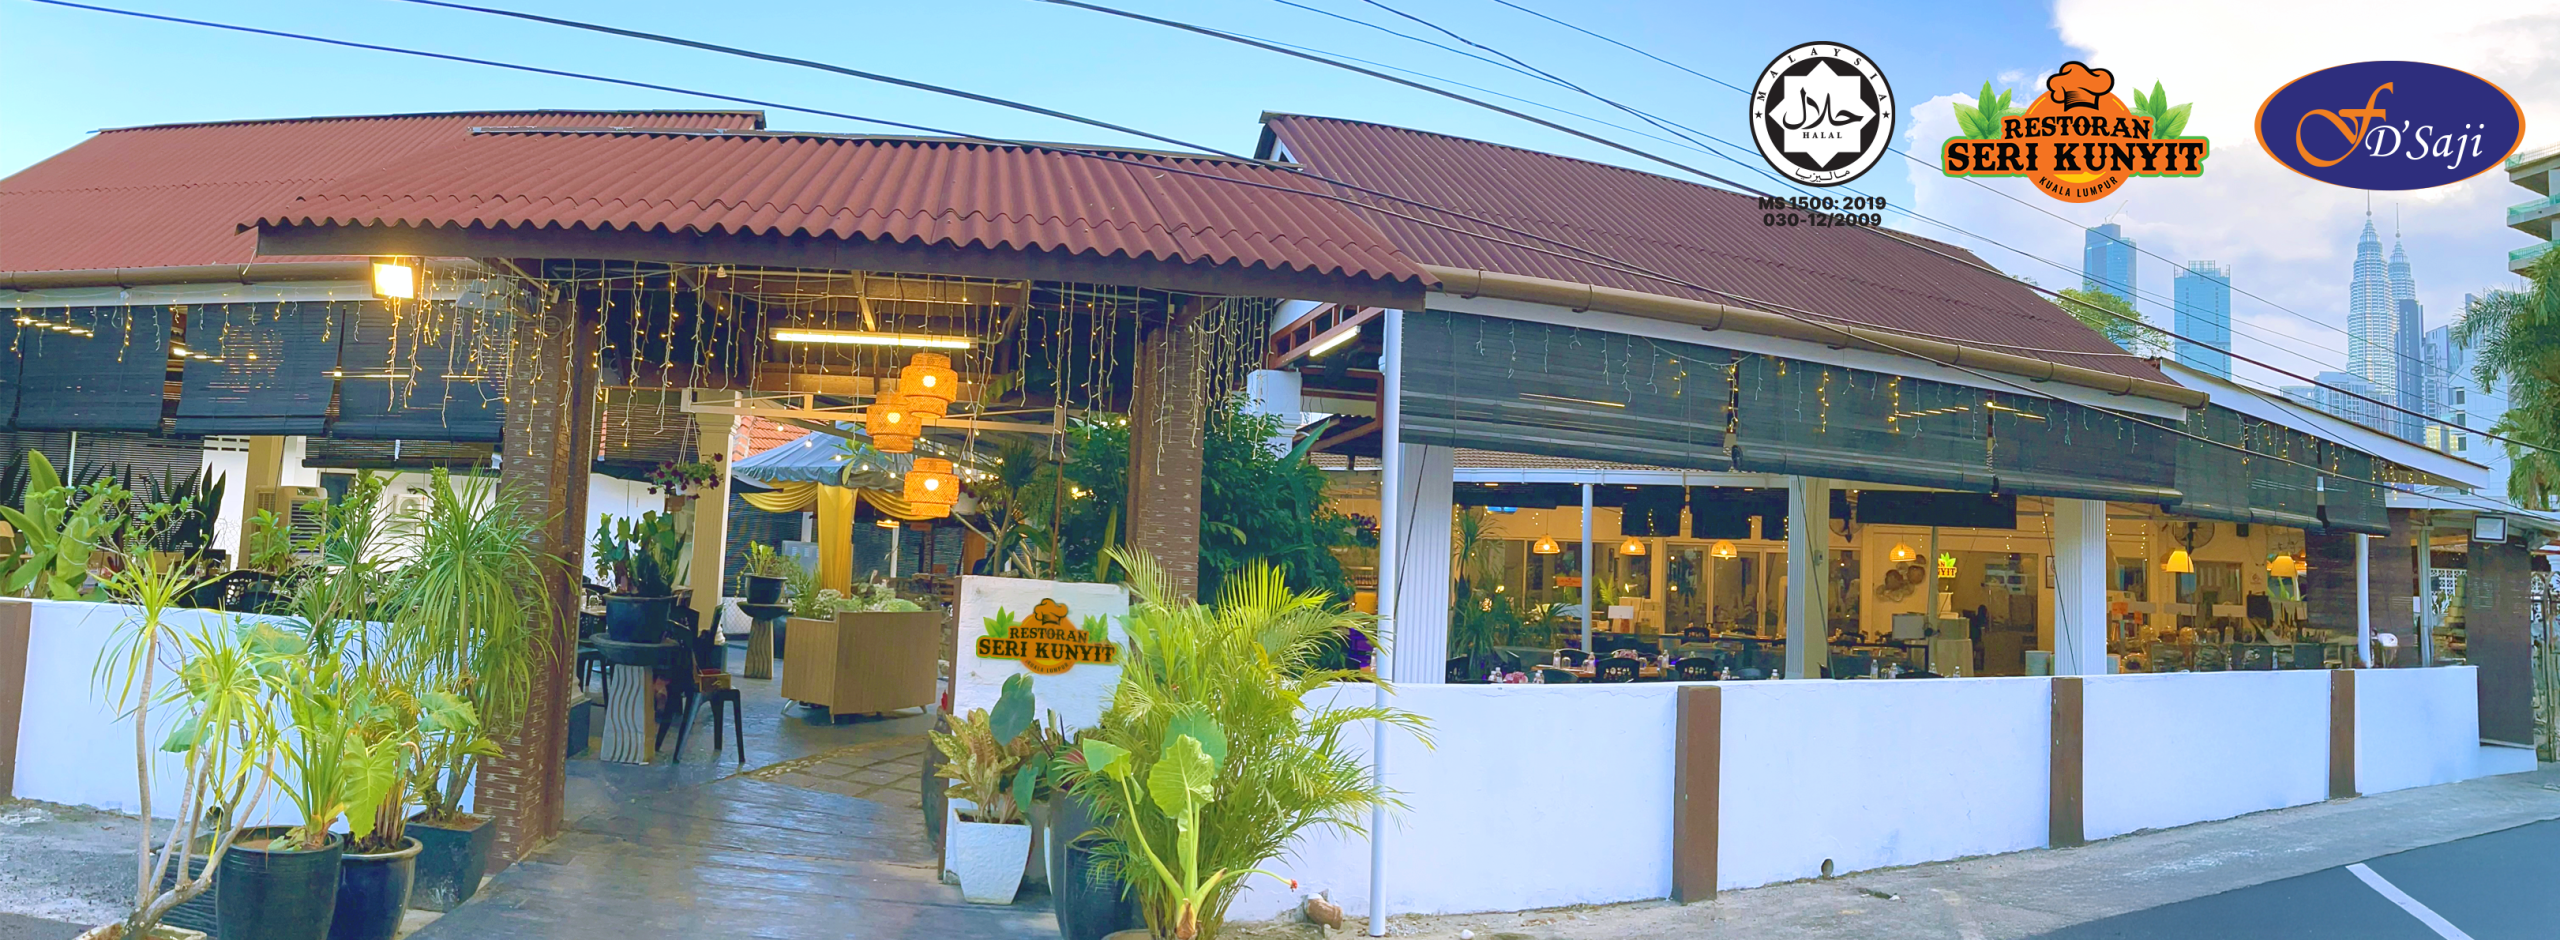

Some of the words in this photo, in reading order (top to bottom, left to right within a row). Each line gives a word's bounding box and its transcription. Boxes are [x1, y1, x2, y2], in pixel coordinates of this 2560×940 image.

[1009, 627, 1089, 643] RESTORAN
[978, 638, 1028, 658] SERI
[1035, 642, 1116, 663] KUNYIT
